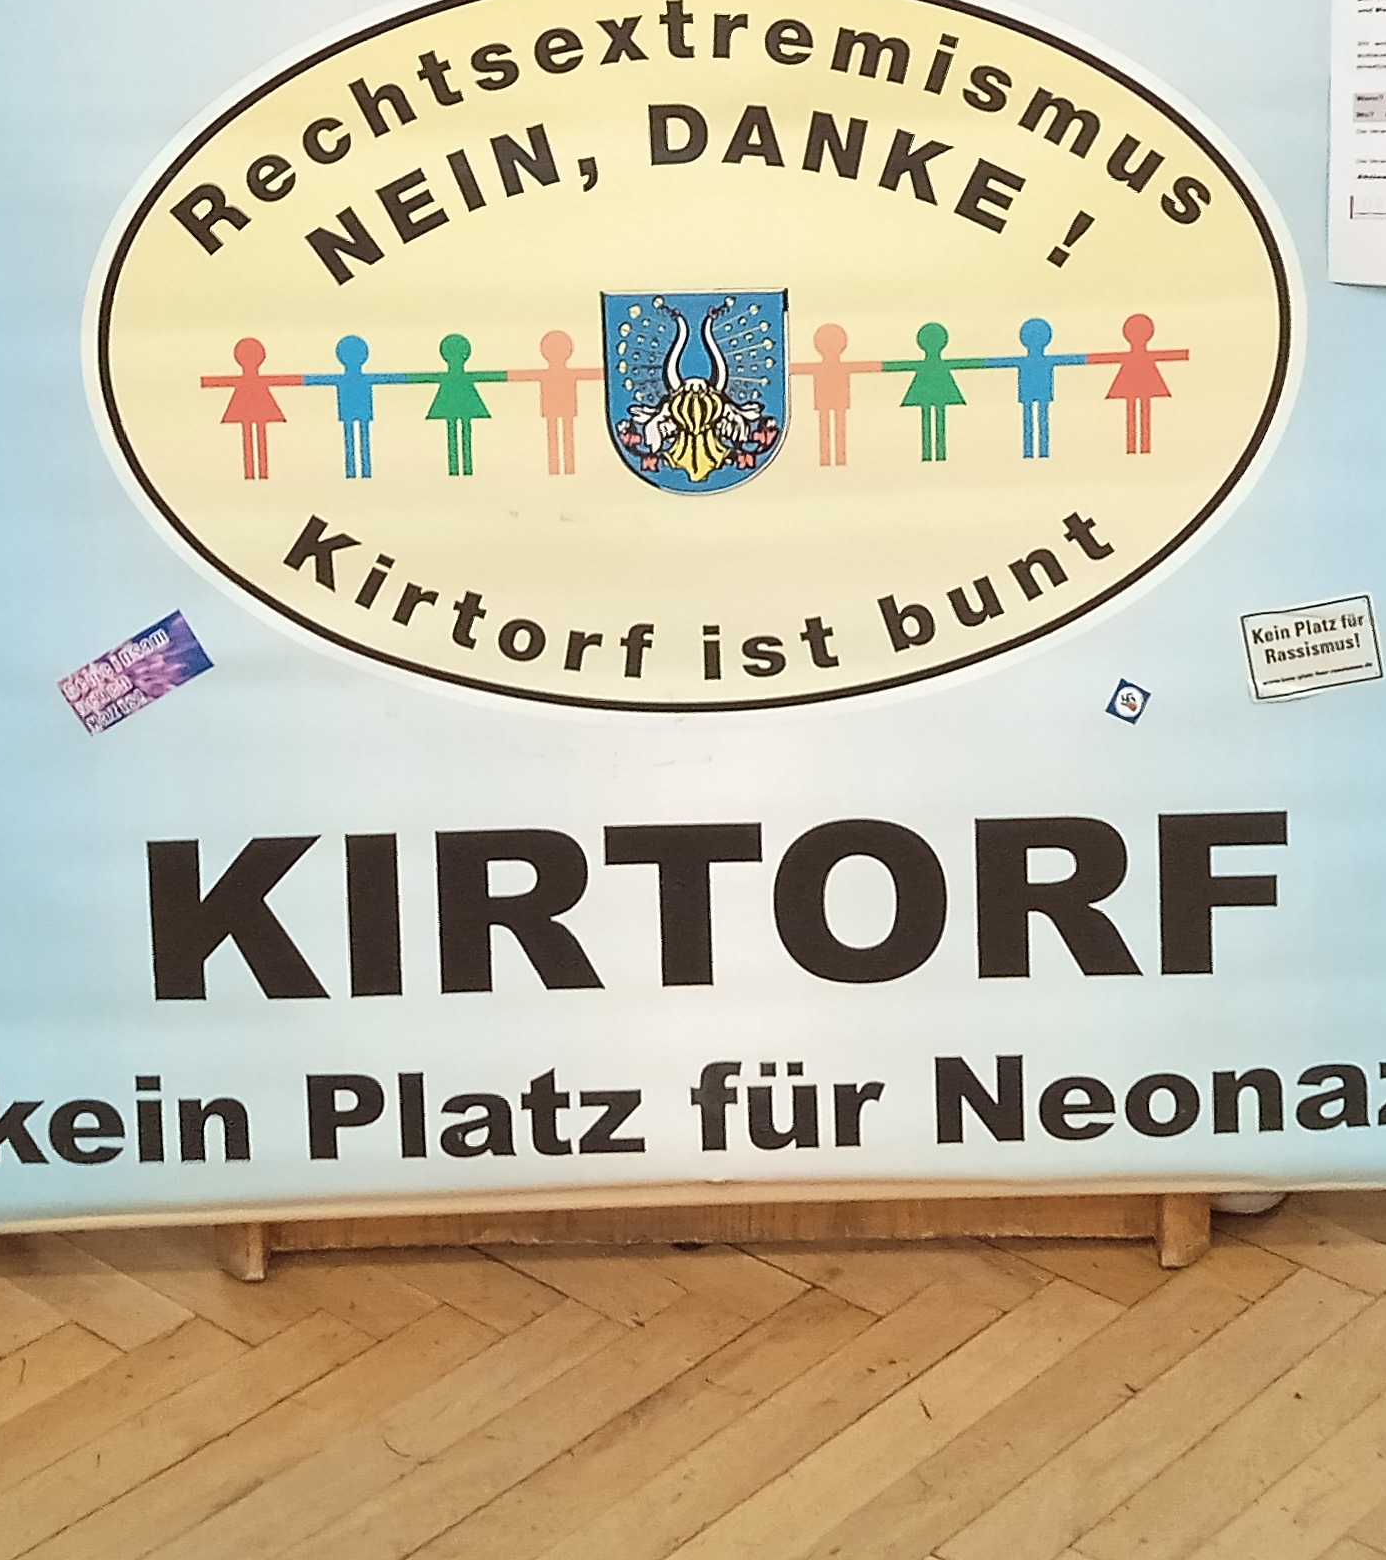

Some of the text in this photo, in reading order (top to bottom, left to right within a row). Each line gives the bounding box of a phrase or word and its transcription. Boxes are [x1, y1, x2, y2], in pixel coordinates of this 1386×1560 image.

[304, 123, 599, 286] NEIN,
[281, 509, 1114, 681] Kirtorf ist bunt
[1251, 613, 1365, 645] Kein Platz für
[1265, 632, 1361, 665] Rassismus!
[146, 810, 1288, 1000] KIRTORF
[305, 1067, 647, 1160] Platz
[690, 1060, 885, 1151] für
